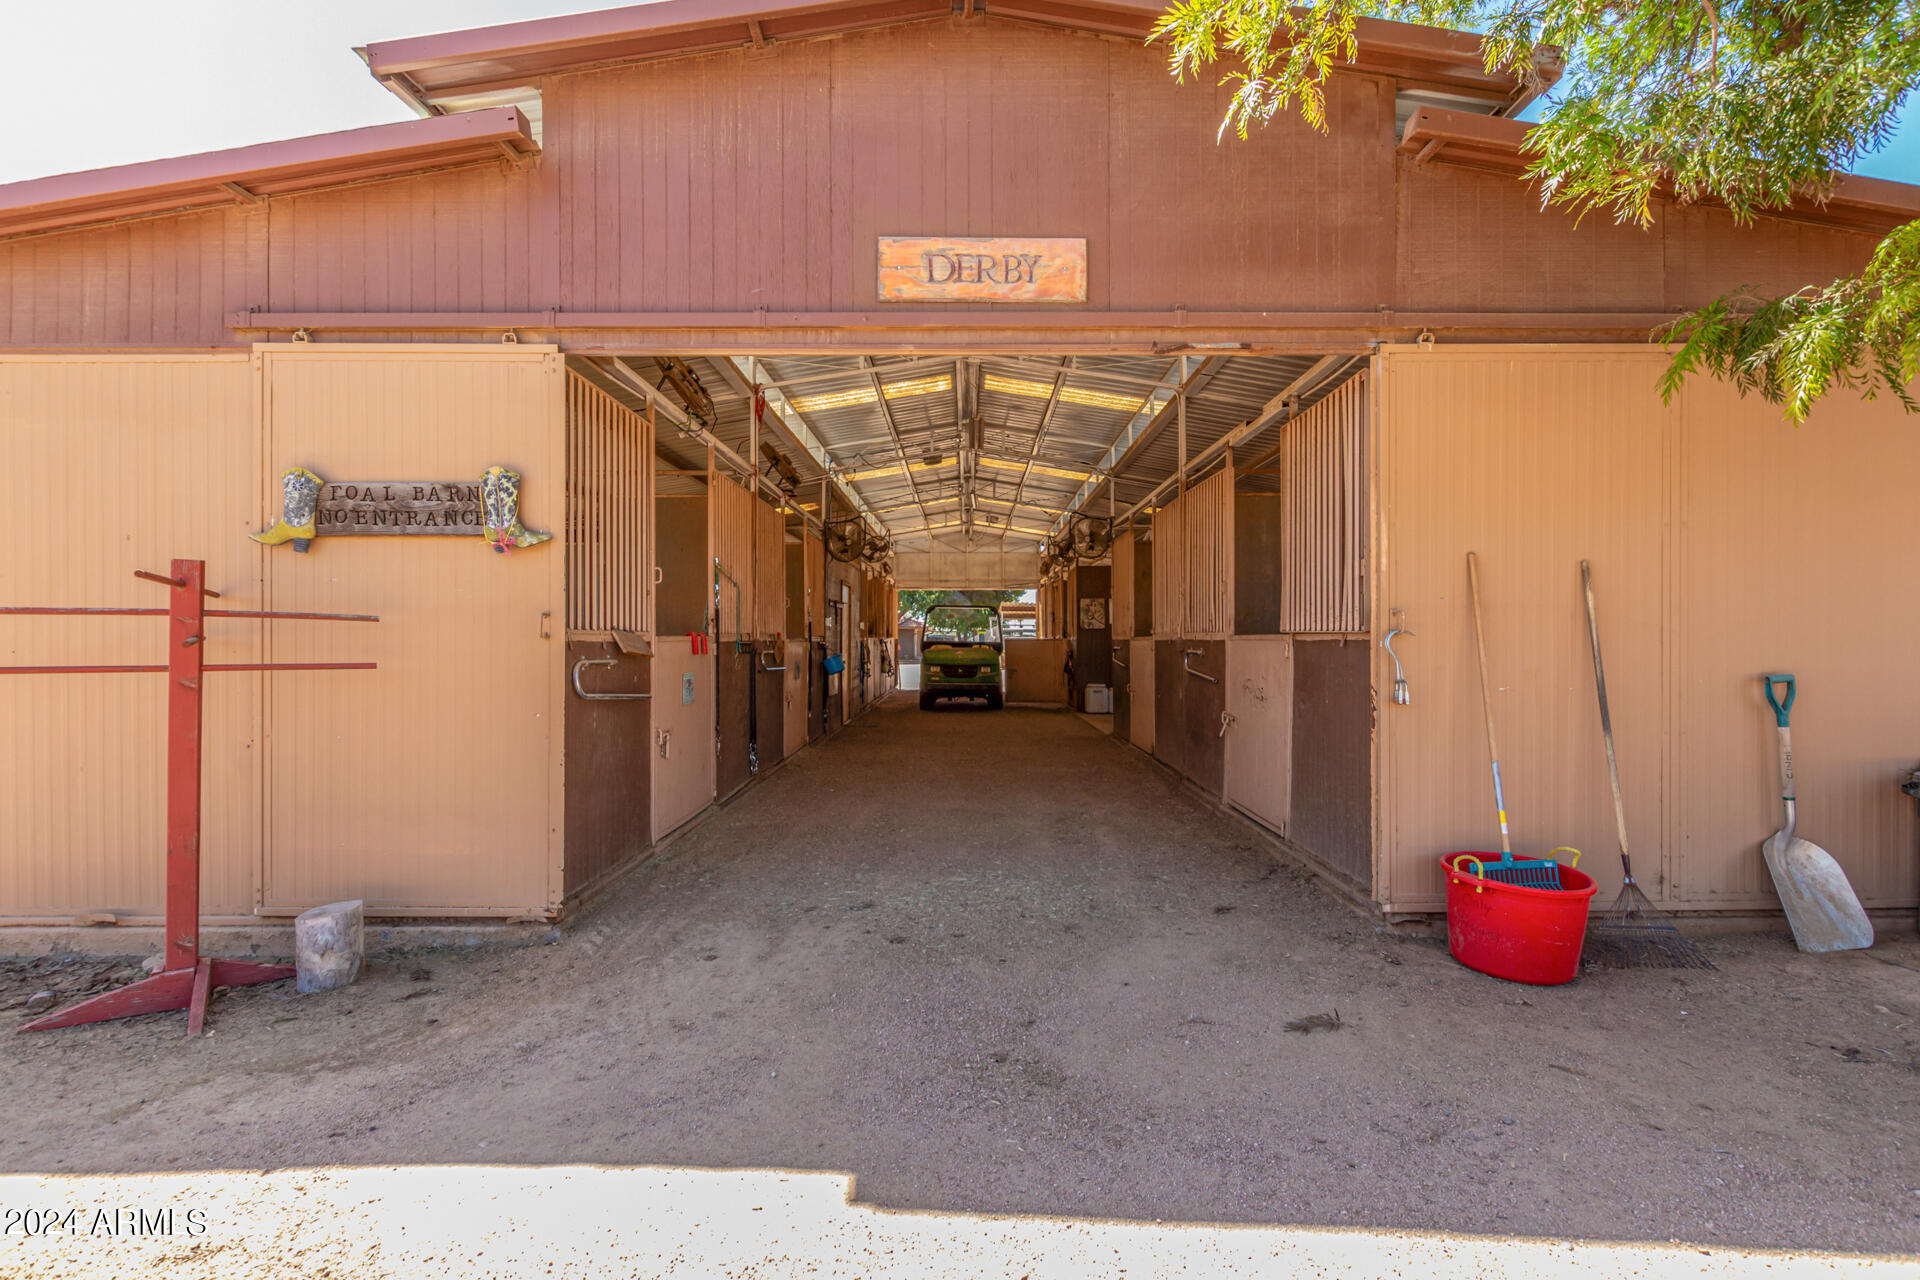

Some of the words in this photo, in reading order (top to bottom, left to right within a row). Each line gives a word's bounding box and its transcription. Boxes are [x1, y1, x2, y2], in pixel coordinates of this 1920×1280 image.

[927, 253, 1042, 284] DERBY
[330, 485, 396, 501] FOAL
[412, 486, 479, 501] BARN
[318, 509, 347, 525] NO
[355, 510, 486, 526] ENTRANCE
